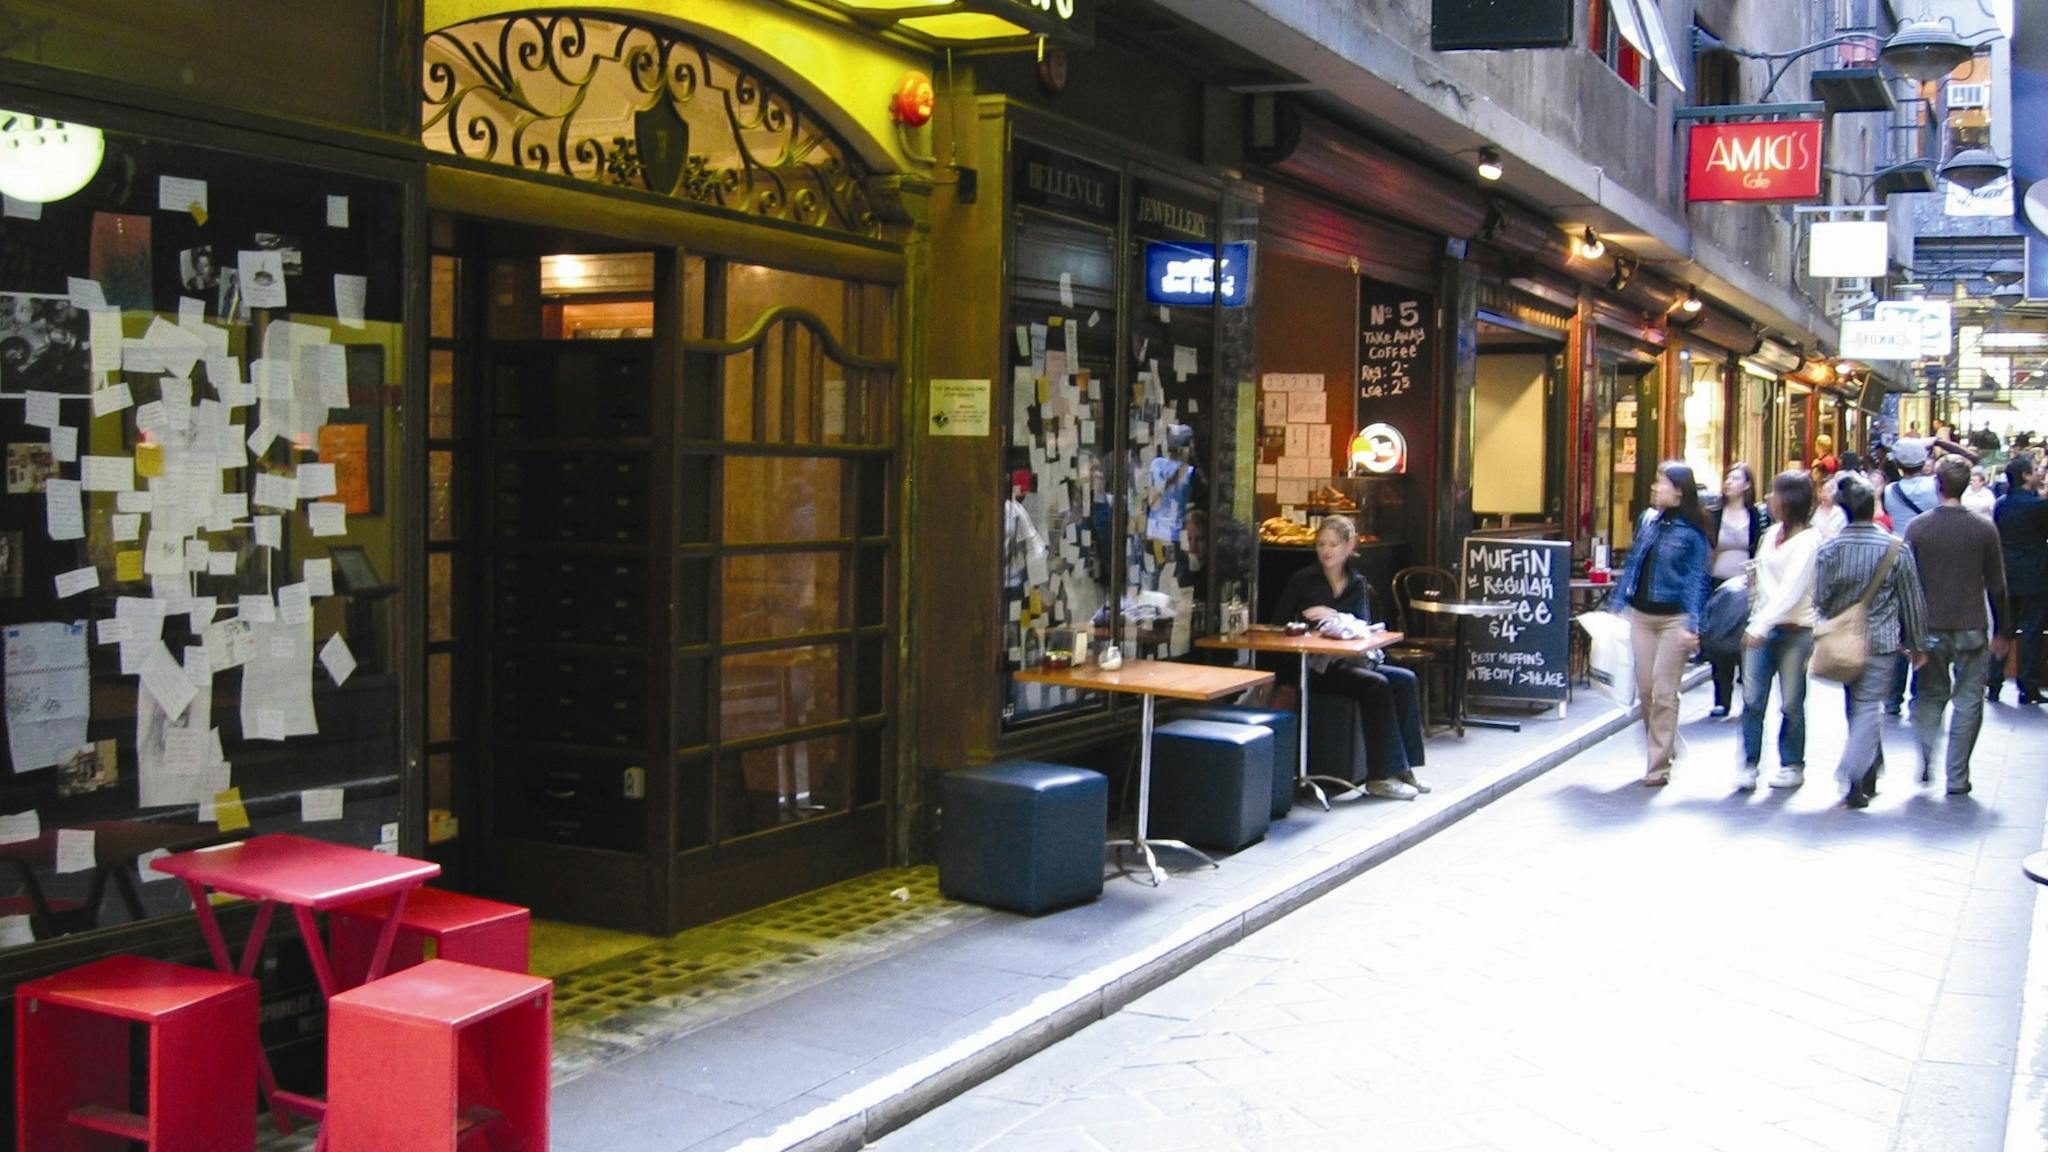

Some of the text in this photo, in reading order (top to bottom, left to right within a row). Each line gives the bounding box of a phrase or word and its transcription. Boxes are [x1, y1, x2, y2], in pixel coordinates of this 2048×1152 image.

[1705, 131, 1809, 172] AMICI'S
[1029, 161, 1208, 238] BELLEVUE JEWELLERY
[1399, 300, 1420, 328] 5
